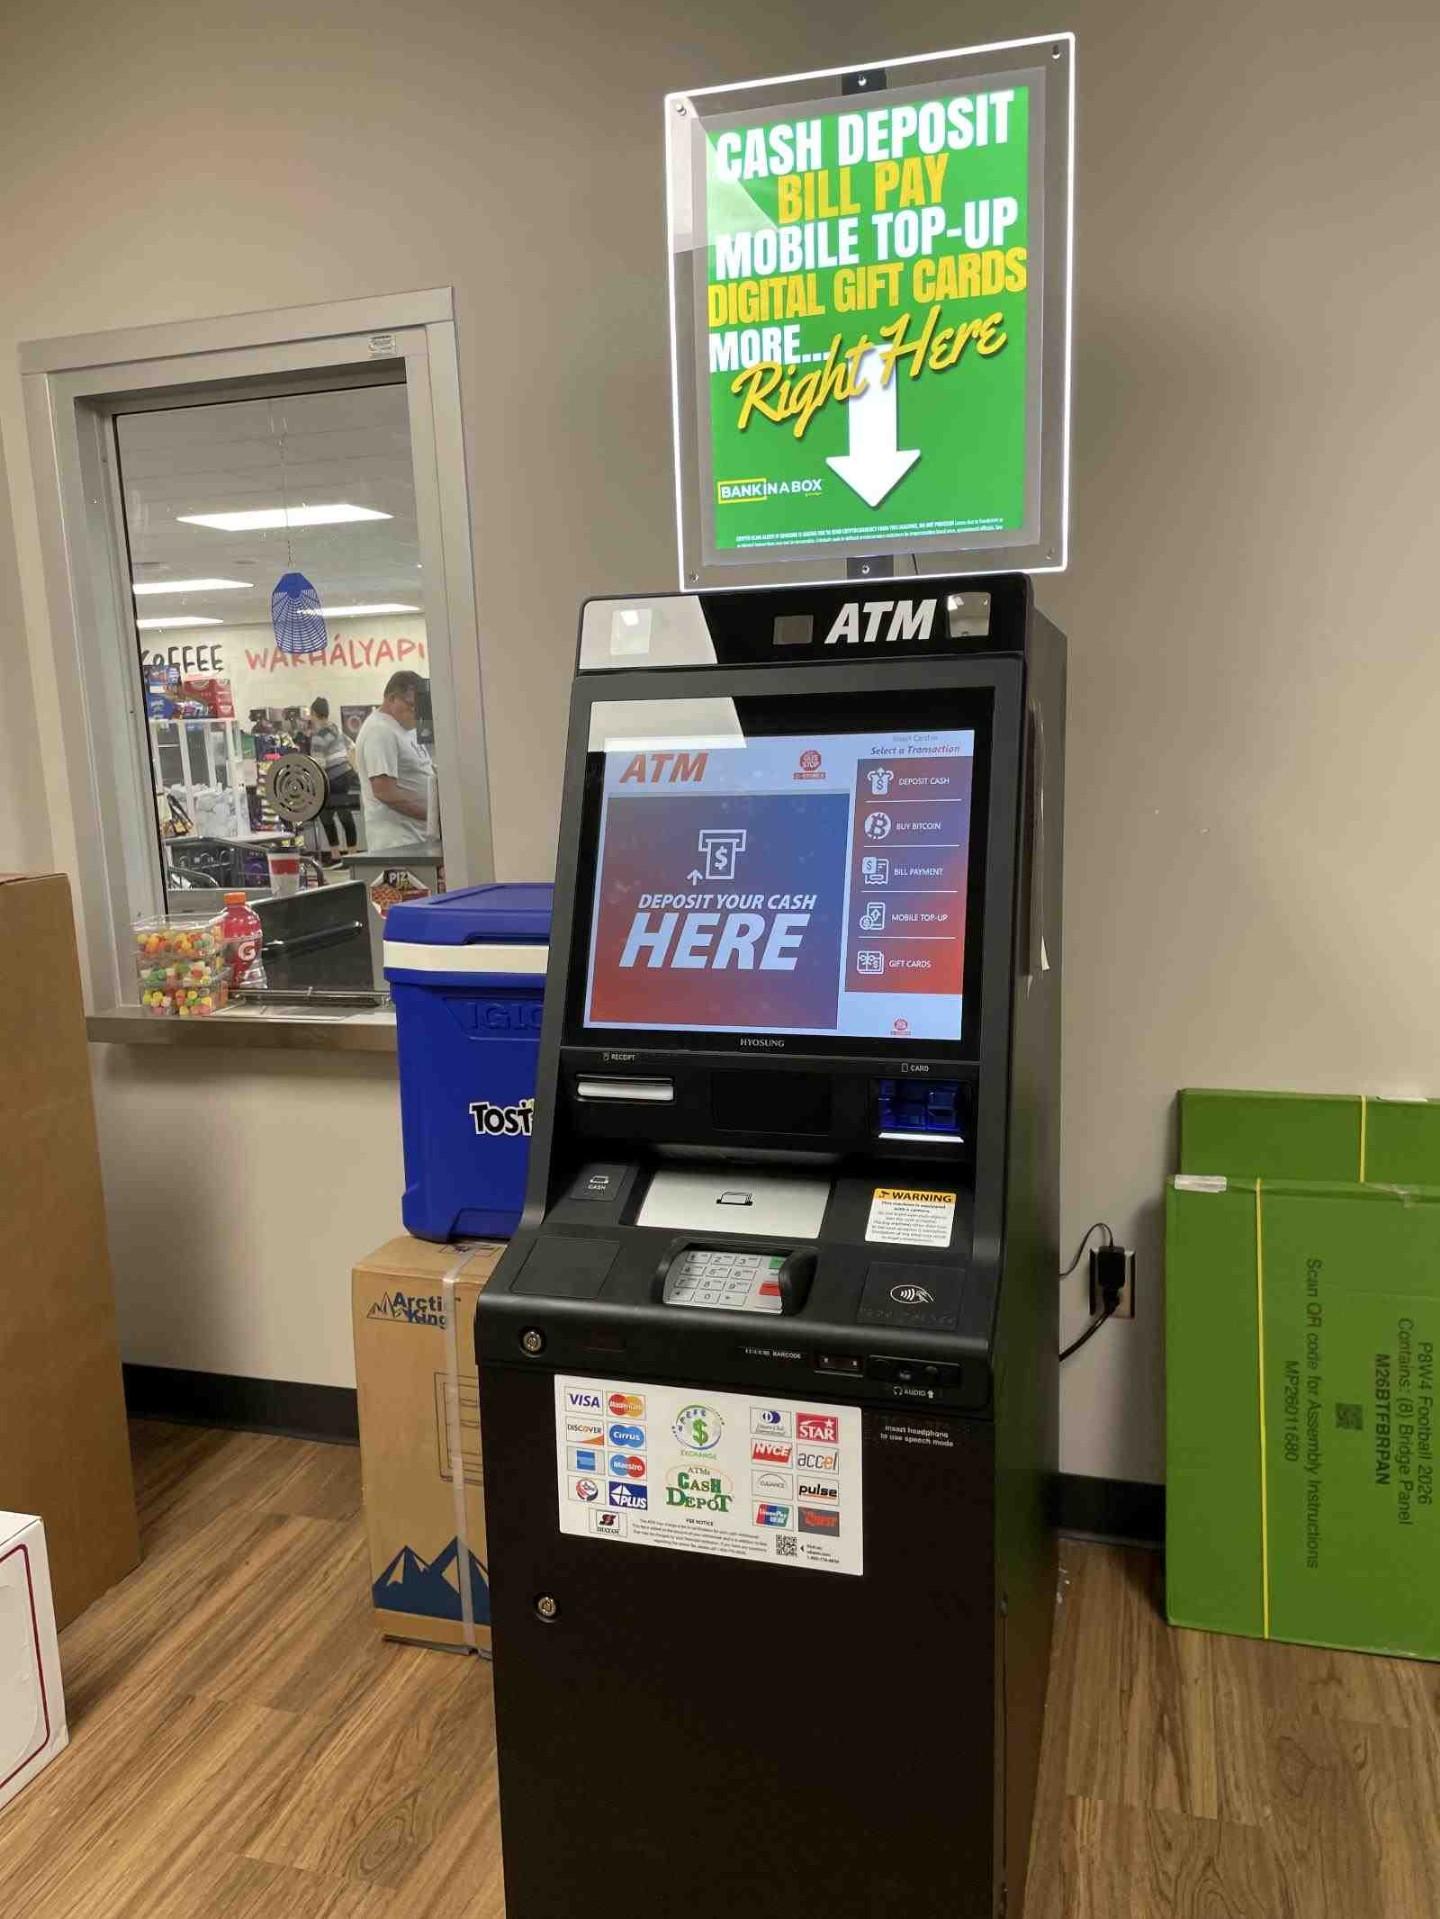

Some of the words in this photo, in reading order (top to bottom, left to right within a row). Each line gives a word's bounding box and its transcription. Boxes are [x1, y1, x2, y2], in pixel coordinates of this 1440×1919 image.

[716, 119, 822, 182] CASH
[838, 89, 1014, 167] DEPOSIT
[777, 167, 860, 224] BILL
[874, 153, 949, 211] PAY
[716, 217, 859, 281] MOBILE
[872, 196, 1018, 261] TOP-UP
[708, 274, 825, 327] DIGITAL
[833, 262, 903, 313] GIFT
[913, 247, 1027, 304] CARDS
[731, 333, 875, 438] Right
[879, 305, 1008, 379] Here
[824, 599, 938, 645] ATM
[871, 746, 897, 755] Select
[907, 744, 961, 755] Transaction
[619, 752, 709, 784] ATM
[899, 777, 928, 787] DEPOSIT
[930, 776, 950, 786] CASH
[896, 822, 911, 831] BUY
[912, 822, 941, 831] BITCOIN
[894, 868, 908, 876] BILL
[909, 868, 943, 876] PAYMENT
[638, 894, 716, 910] DEPOSIT
[716, 894, 763, 910] YOUR
[767, 894, 817, 910] CASH
[892, 914, 919, 922] MOBILE
[920, 914, 949, 922] TOP-UP
[238, 941, 257, 961] G
[619, 912, 811, 970] HERE
[889, 960, 905, 968] GIFT
[906, 960, 931, 968] CARDS
[740, 1038, 785, 1047] HYOSUNG
[611, 1053, 636, 1061] RECEIPT
[910, 1064, 929, 1072] CARD
[892, 1191, 951, 1203] WARNING
[1306, 1258, 1322, 1297] Scan
[393, 1292, 461, 1312] Arcti
[1306, 1302, 1322, 1328] QR
[772, 1350, 801, 1359] BARCODE
[1306, 1333, 1321, 1370] code
[1398, 1318, 1414, 1393] Contains:
[1417, 1342, 1433, 1390] P8W4
[904, 1388, 926, 1397] AUDIO
[1306, 1375, 1323, 1396] for
[569, 1394, 600, 1408] VISA
[567, 1423, 602, 1434] DISCOVER
[613, 1431, 641, 1441] Cirrus
[799, 1425, 835, 1441] STAR
[1304, 1400, 1322, 1476] Assembly
[1417, 1396, 1433, 1460] Football
[755, 1442, 791, 1457] NYCE
[1395, 1424, 1414, 1476] Bridge
[613, 1461, 643, 1472] Maestro
[797, 1451, 838, 1471] accel
[798, 1483, 838, 1498] pulse
[1417, 1465, 1433, 1505] 2026
[620, 1494, 647, 1508] PLUS
[1399, 1480, 1414, 1525] Panel
[1306, 1479, 1322, 1569] Instructions
